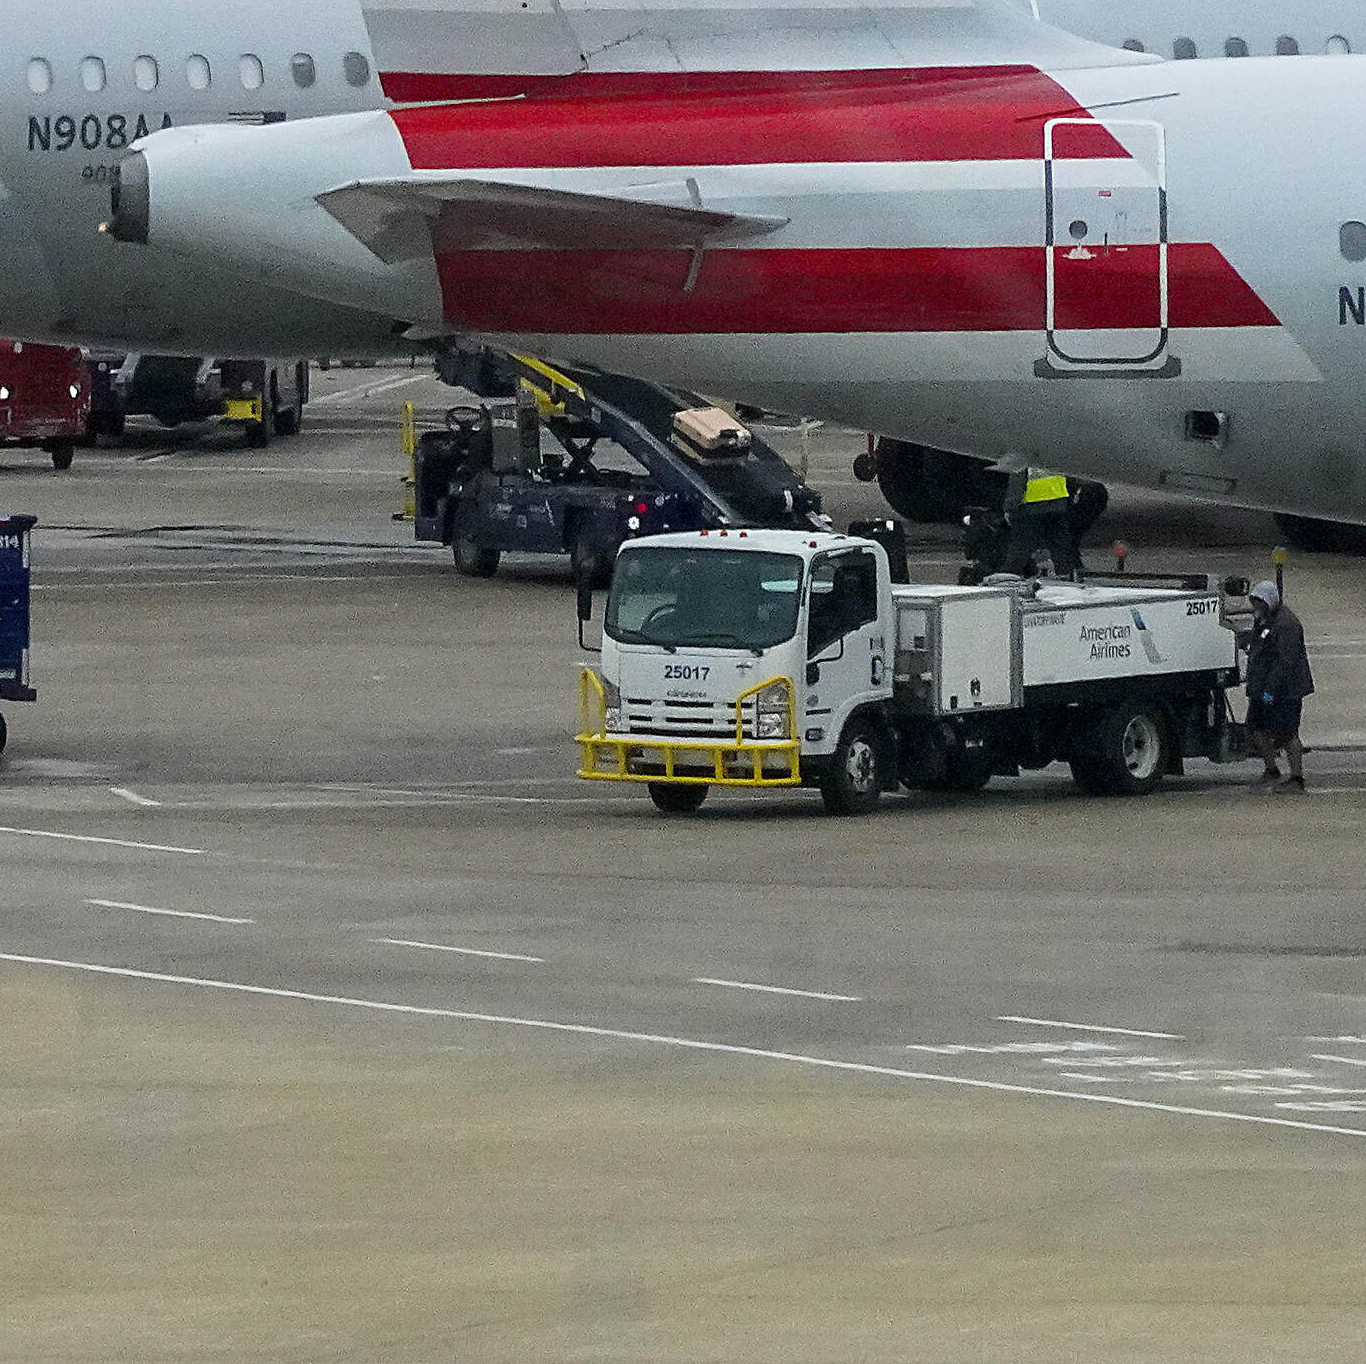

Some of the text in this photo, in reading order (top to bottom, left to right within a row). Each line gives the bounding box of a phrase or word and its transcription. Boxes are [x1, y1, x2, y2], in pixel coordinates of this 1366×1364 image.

[1185, 600, 1219, 616] 25017
[1079, 624, 1131, 642] American
[1089, 642, 1131, 660] Airlines
[664, 664, 711, 681] 25017
